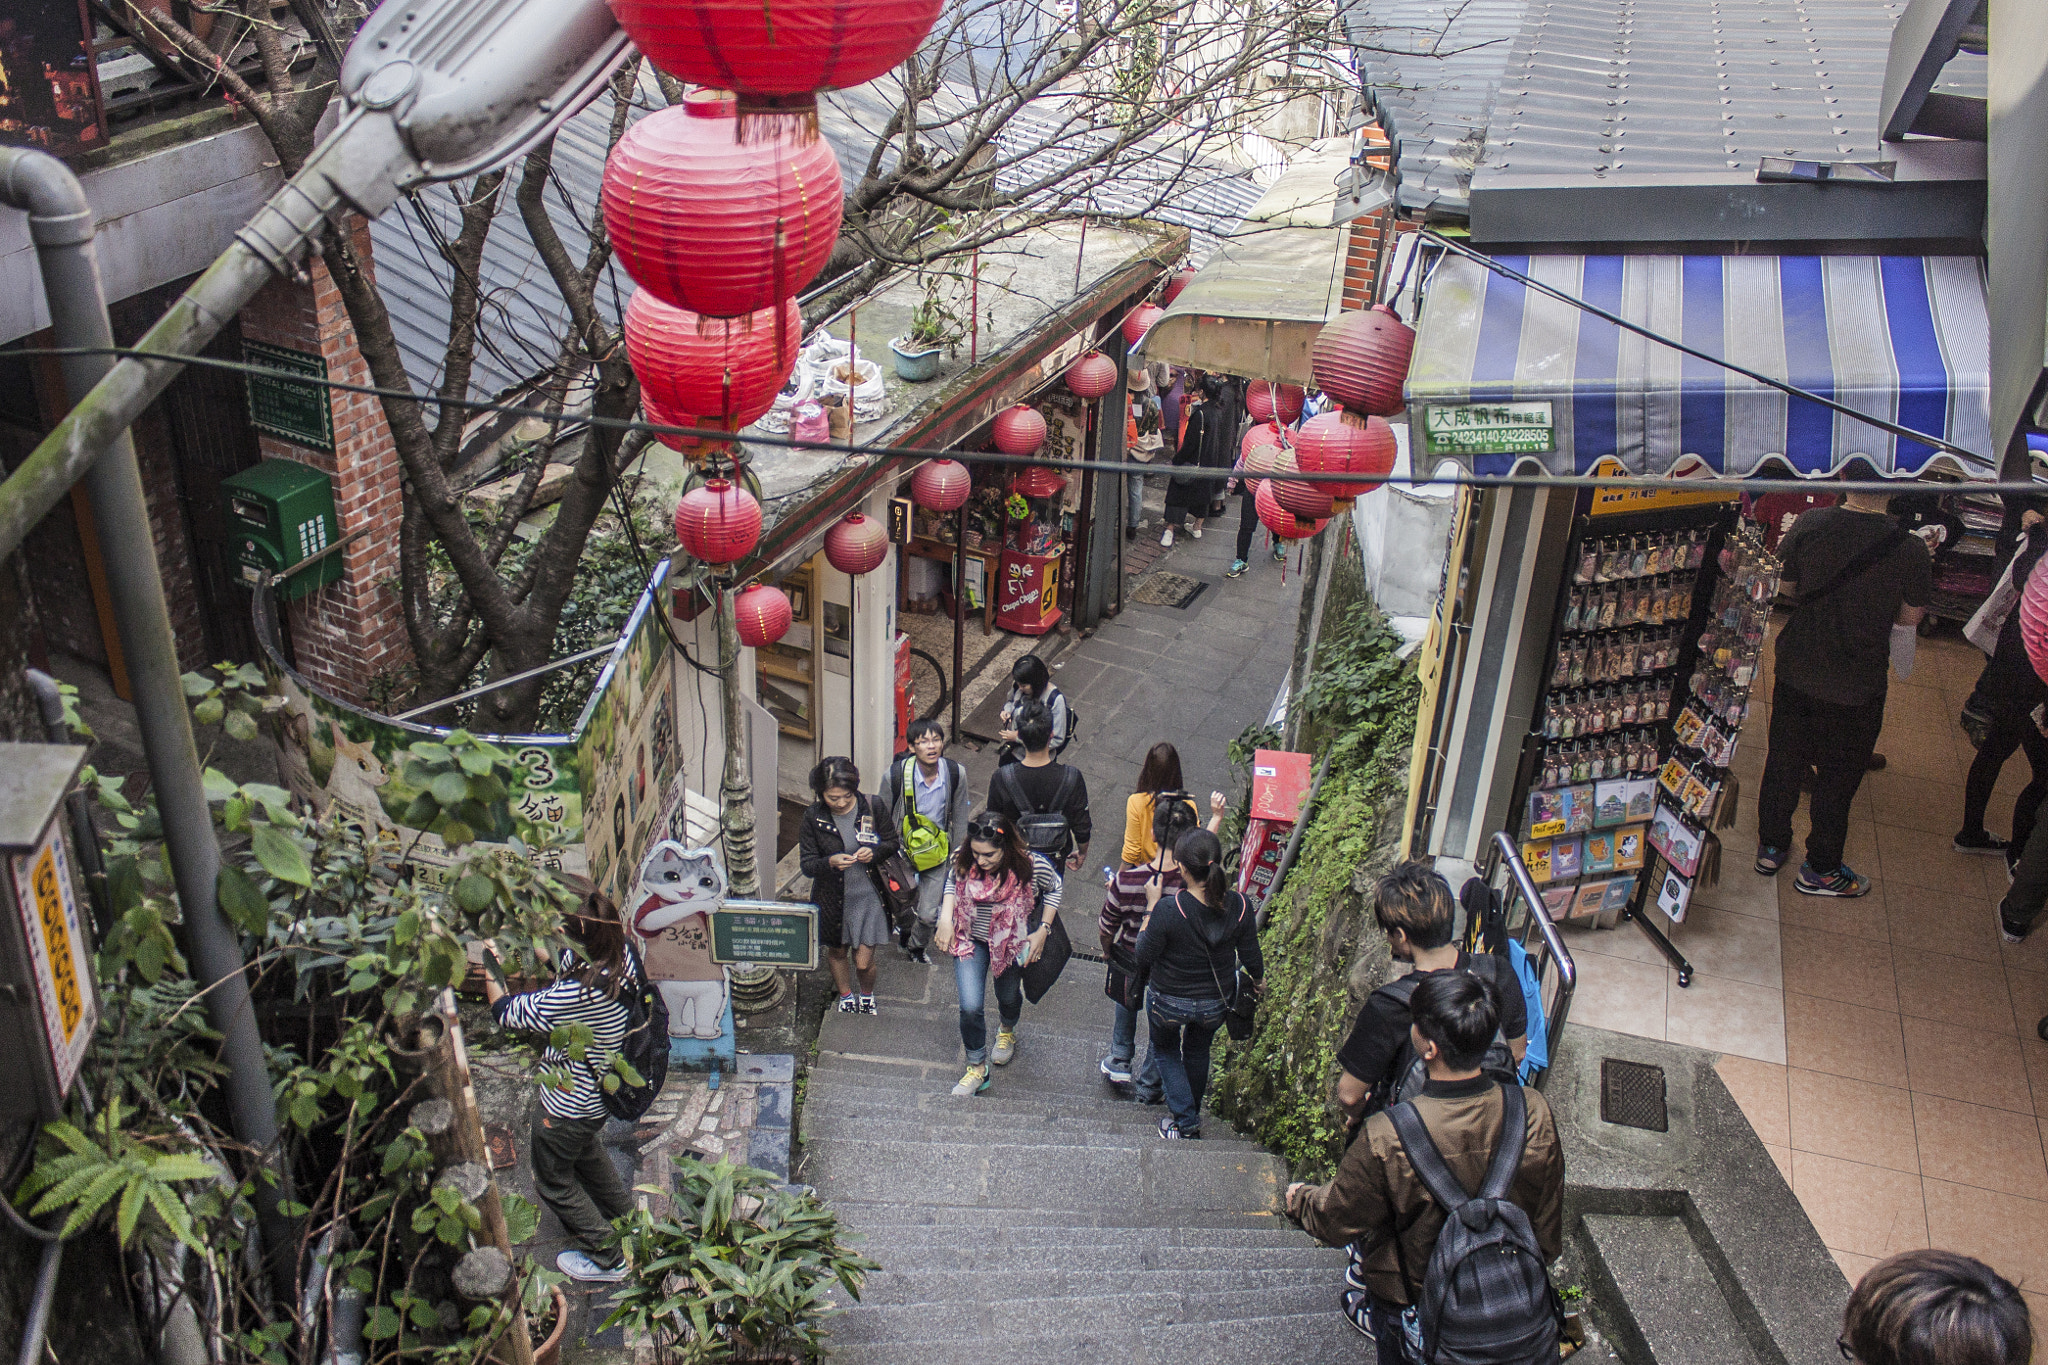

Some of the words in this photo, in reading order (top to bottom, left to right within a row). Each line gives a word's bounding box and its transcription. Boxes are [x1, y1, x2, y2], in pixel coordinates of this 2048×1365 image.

[1434, 407, 1510, 428] 大成帆布
[1451, 429, 1549, 445] 24234140-24228505
[1002, 600, 1020, 613] Chupa
[1019, 588, 1039, 604] Chups
